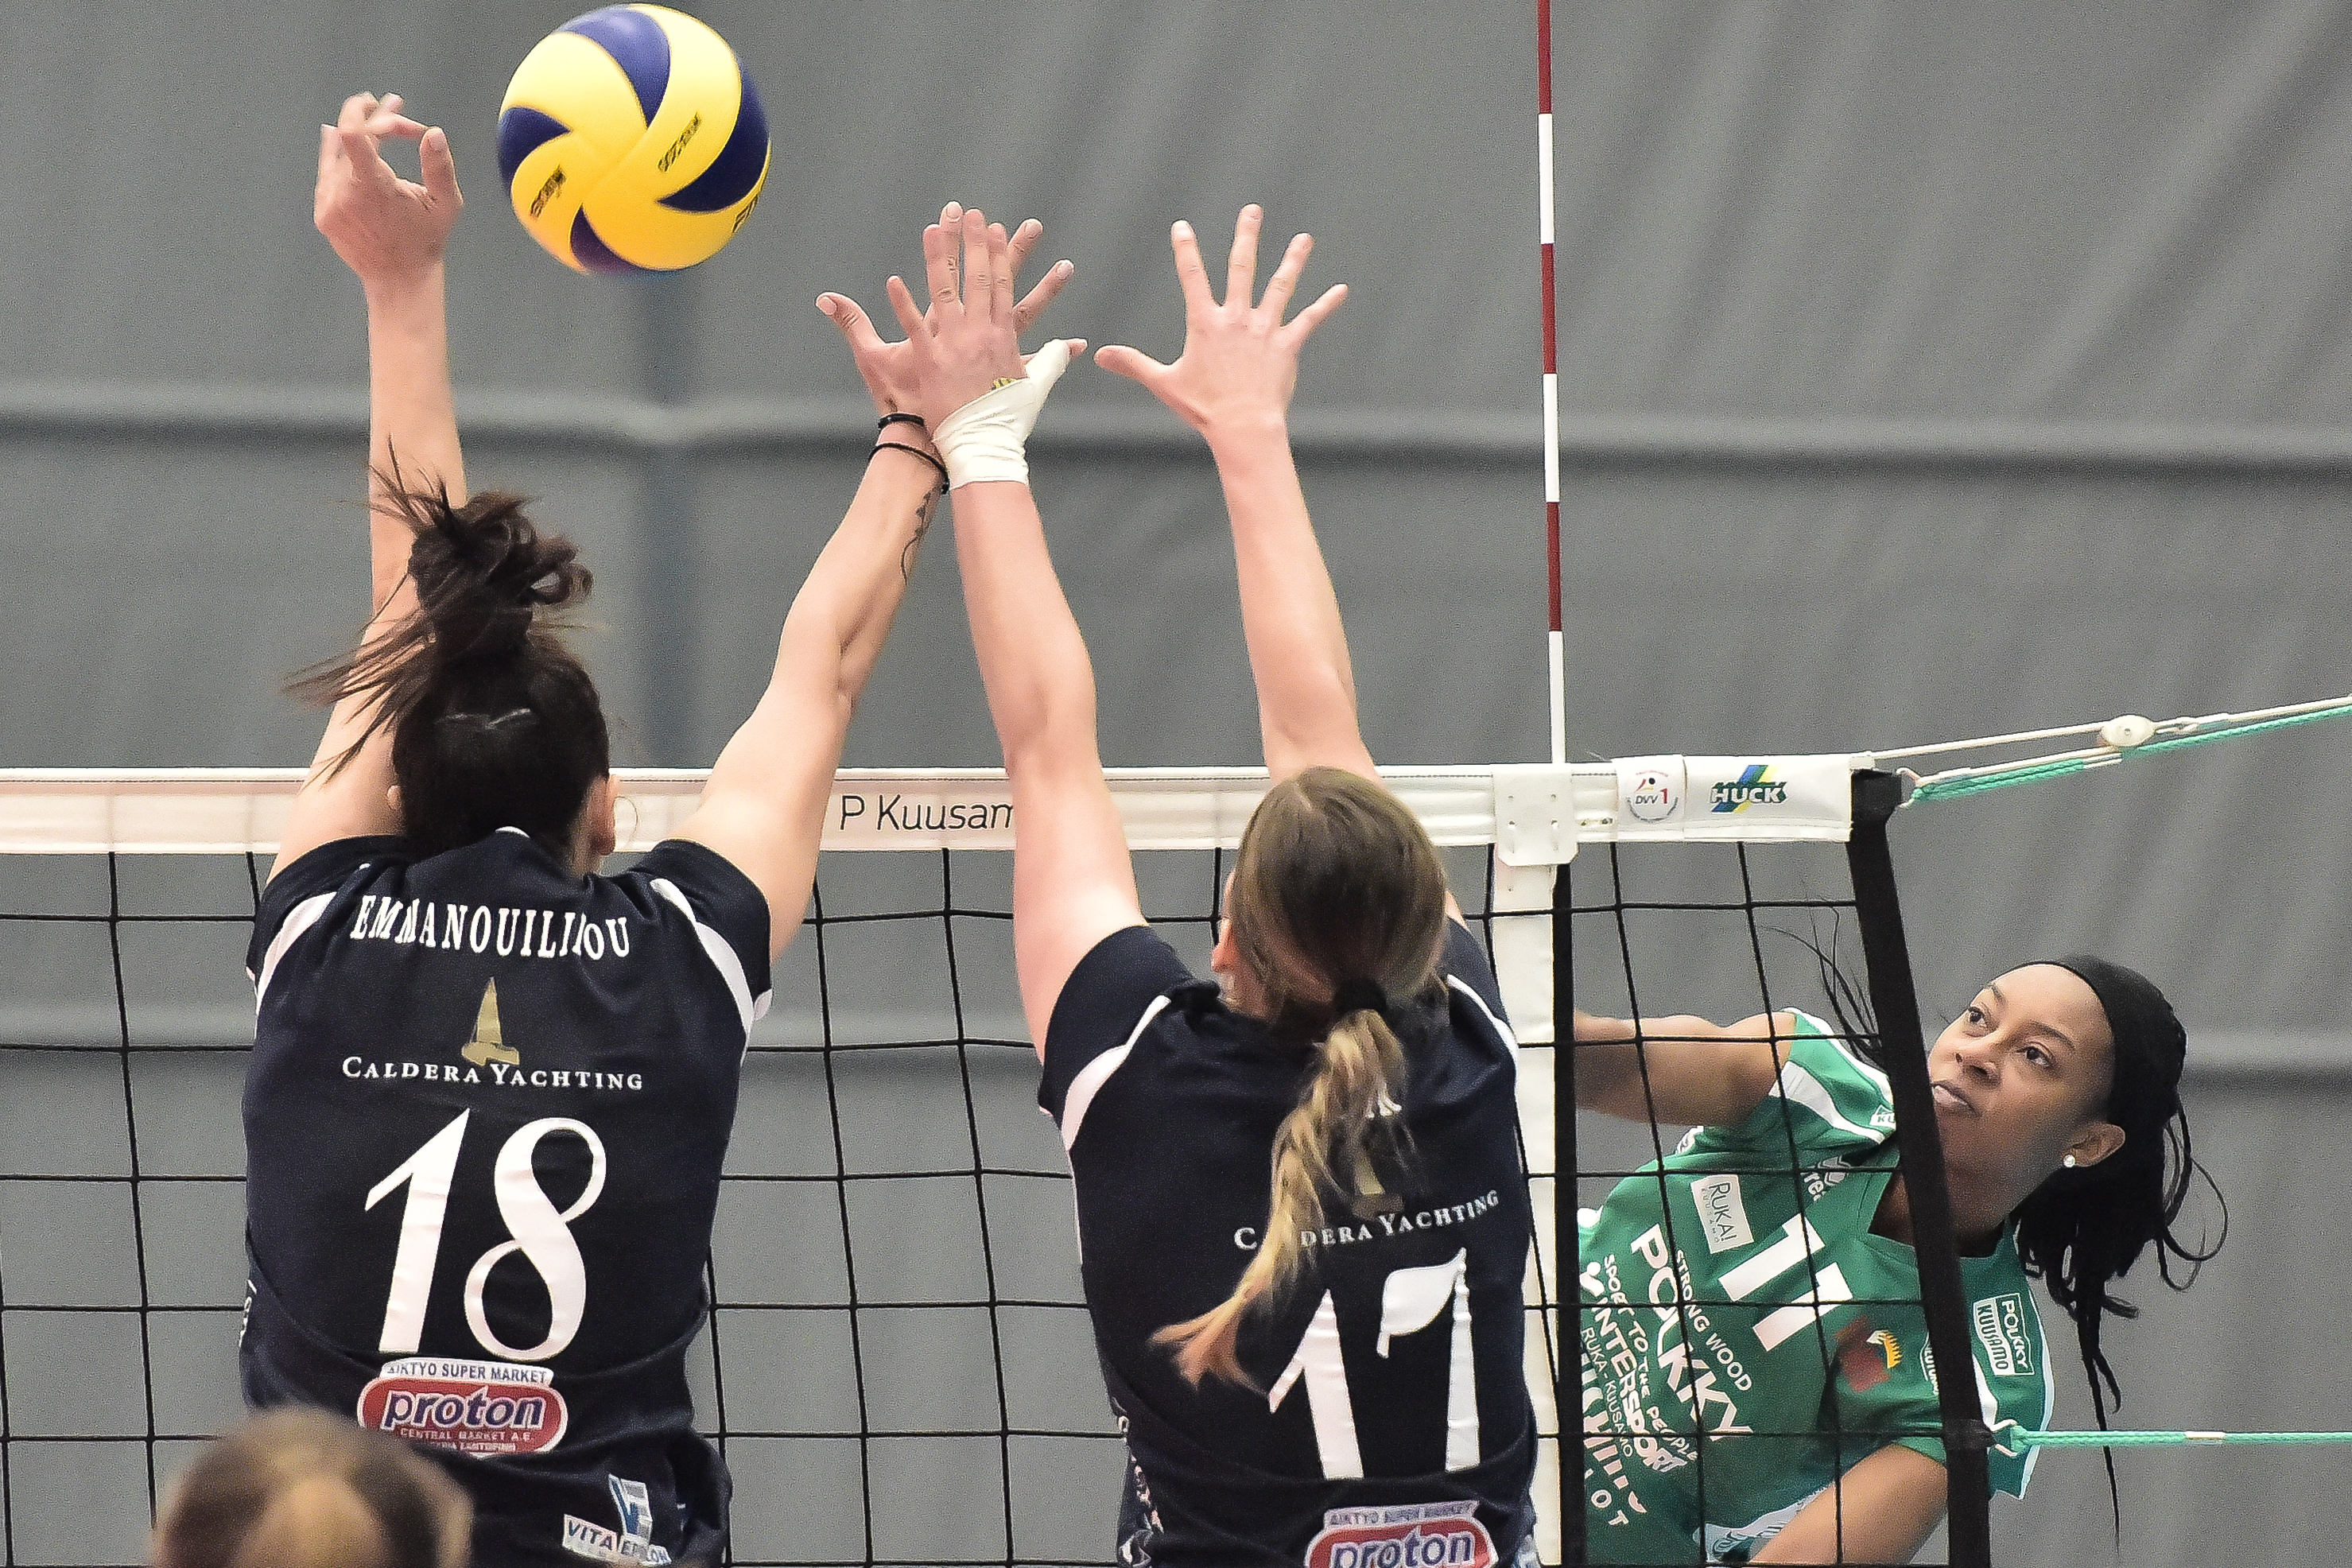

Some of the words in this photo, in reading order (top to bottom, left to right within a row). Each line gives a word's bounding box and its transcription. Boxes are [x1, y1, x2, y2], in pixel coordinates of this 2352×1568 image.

[839, 794, 866, 831] P
[1636, 795, 1658, 805] DVV
[1660, 788, 1668, 804] 1
[1711, 787, 1782, 804] HUCK
[342, 1056, 481, 1084] CALDERA
[490, 1062, 643, 1090] YACHTING
[364, 1108, 606, 1360] 18
[1234, 1223, 1373, 1250] CDERA
[1378, 1190, 1500, 1236] YACHTING
[1709, 1182, 1737, 1241] RUKA!
[1717, 1212, 1853, 1352] 11
[1604, 1254, 1635, 1316] SPORT
[1628, 1321, 1648, 1352] TO
[1638, 1356, 1651, 1399] THE
[1677, 1249, 1710, 1333] STRONG
[1706, 1333, 1752, 1391] WOOD
[1977, 1305, 2009, 1370] KUUSAMO
[442, 1363, 486, 1380] SUPER
[491, 1366, 548, 1384] MARKET
[1268, 1247, 1481, 1481] 17
[380, 1385, 547, 1430] proton
[1330, 1524, 1476, 1568] proton
